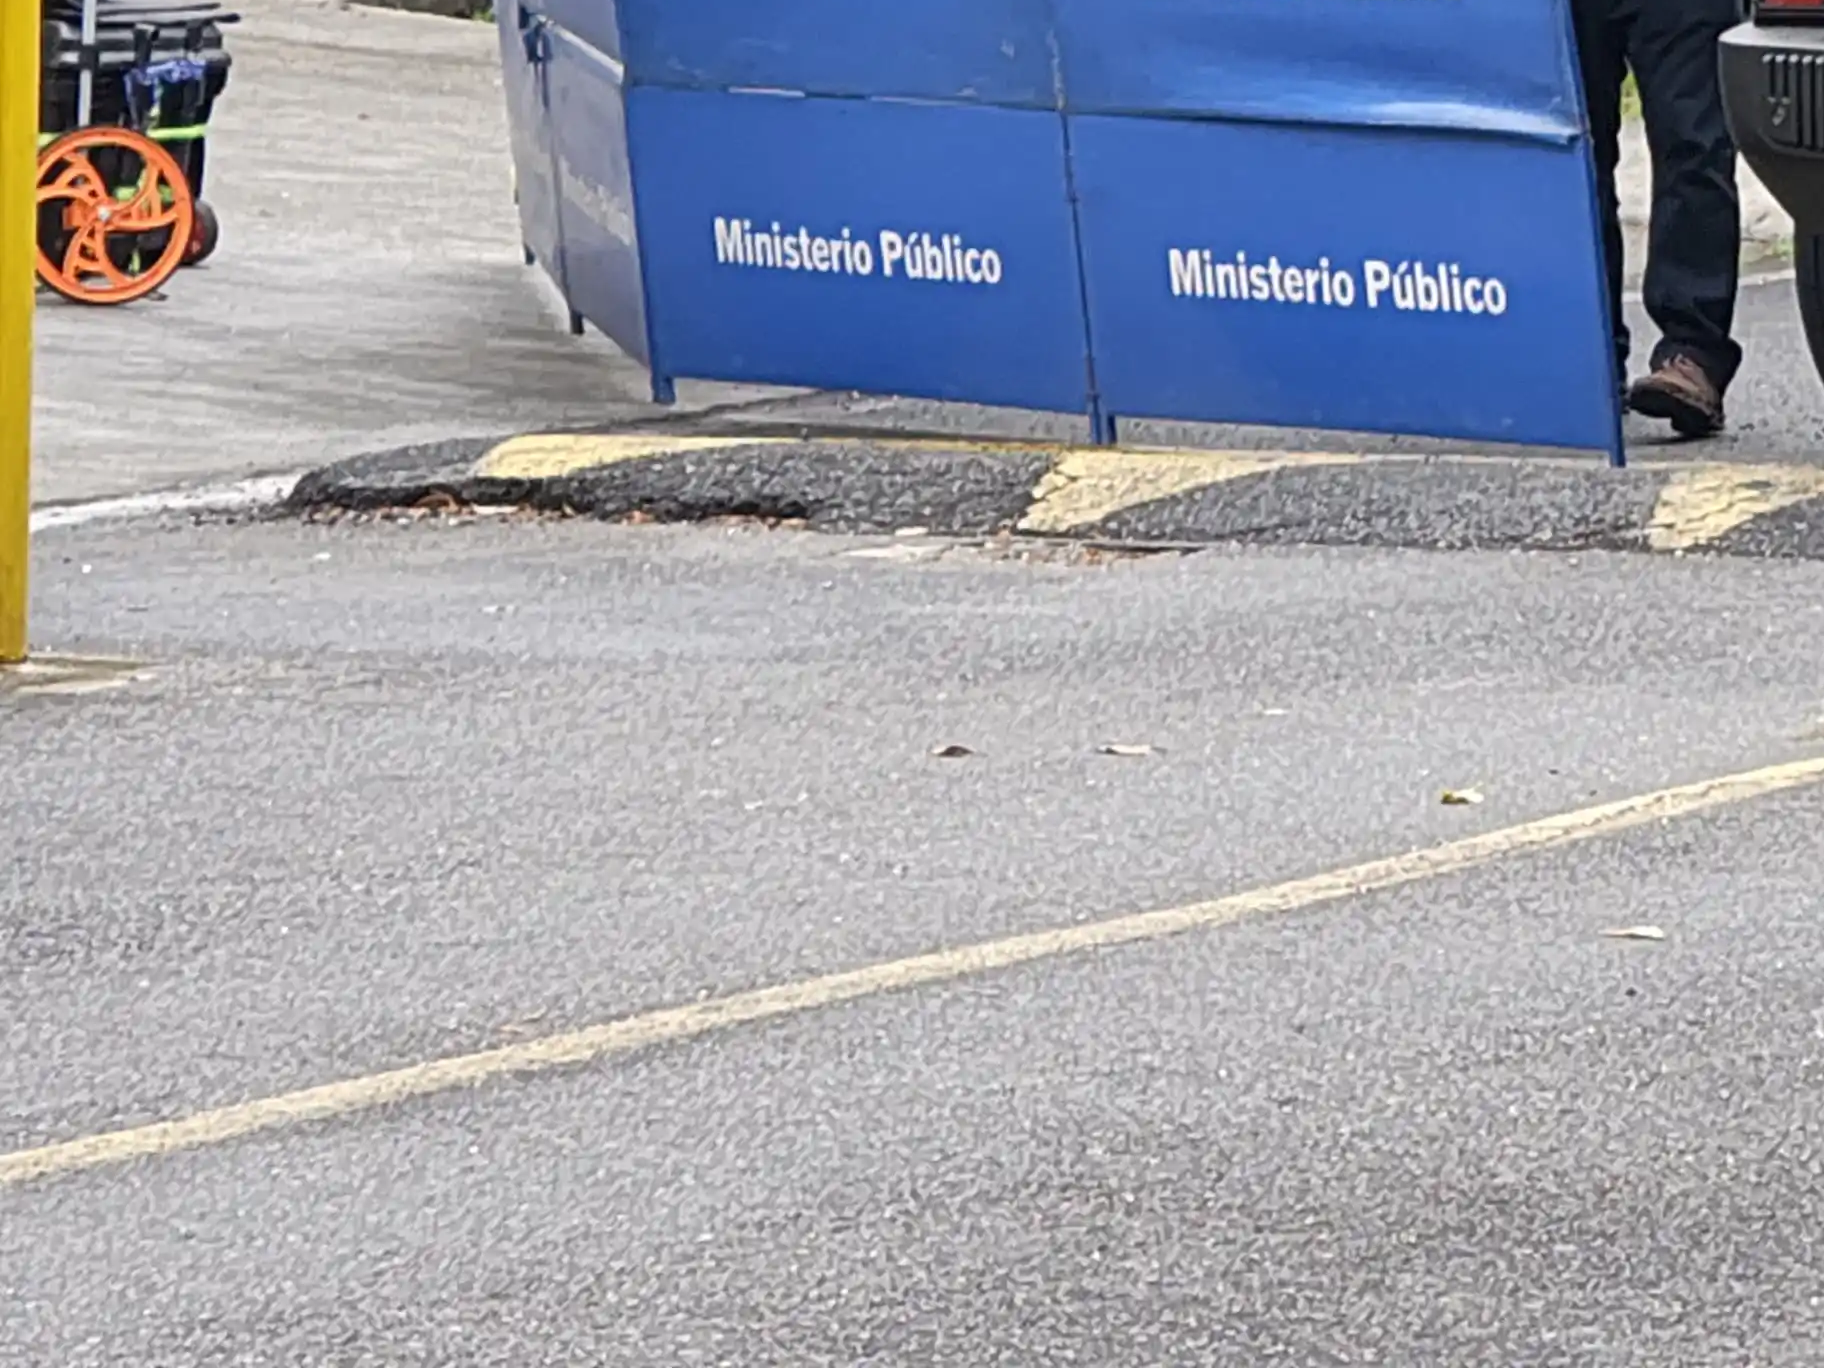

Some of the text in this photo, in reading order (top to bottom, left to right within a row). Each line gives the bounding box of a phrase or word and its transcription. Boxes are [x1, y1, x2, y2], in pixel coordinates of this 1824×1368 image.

[713, 215, 1003, 285] Ministerio Público
[1168, 247, 1508, 316] Ministerio Público
